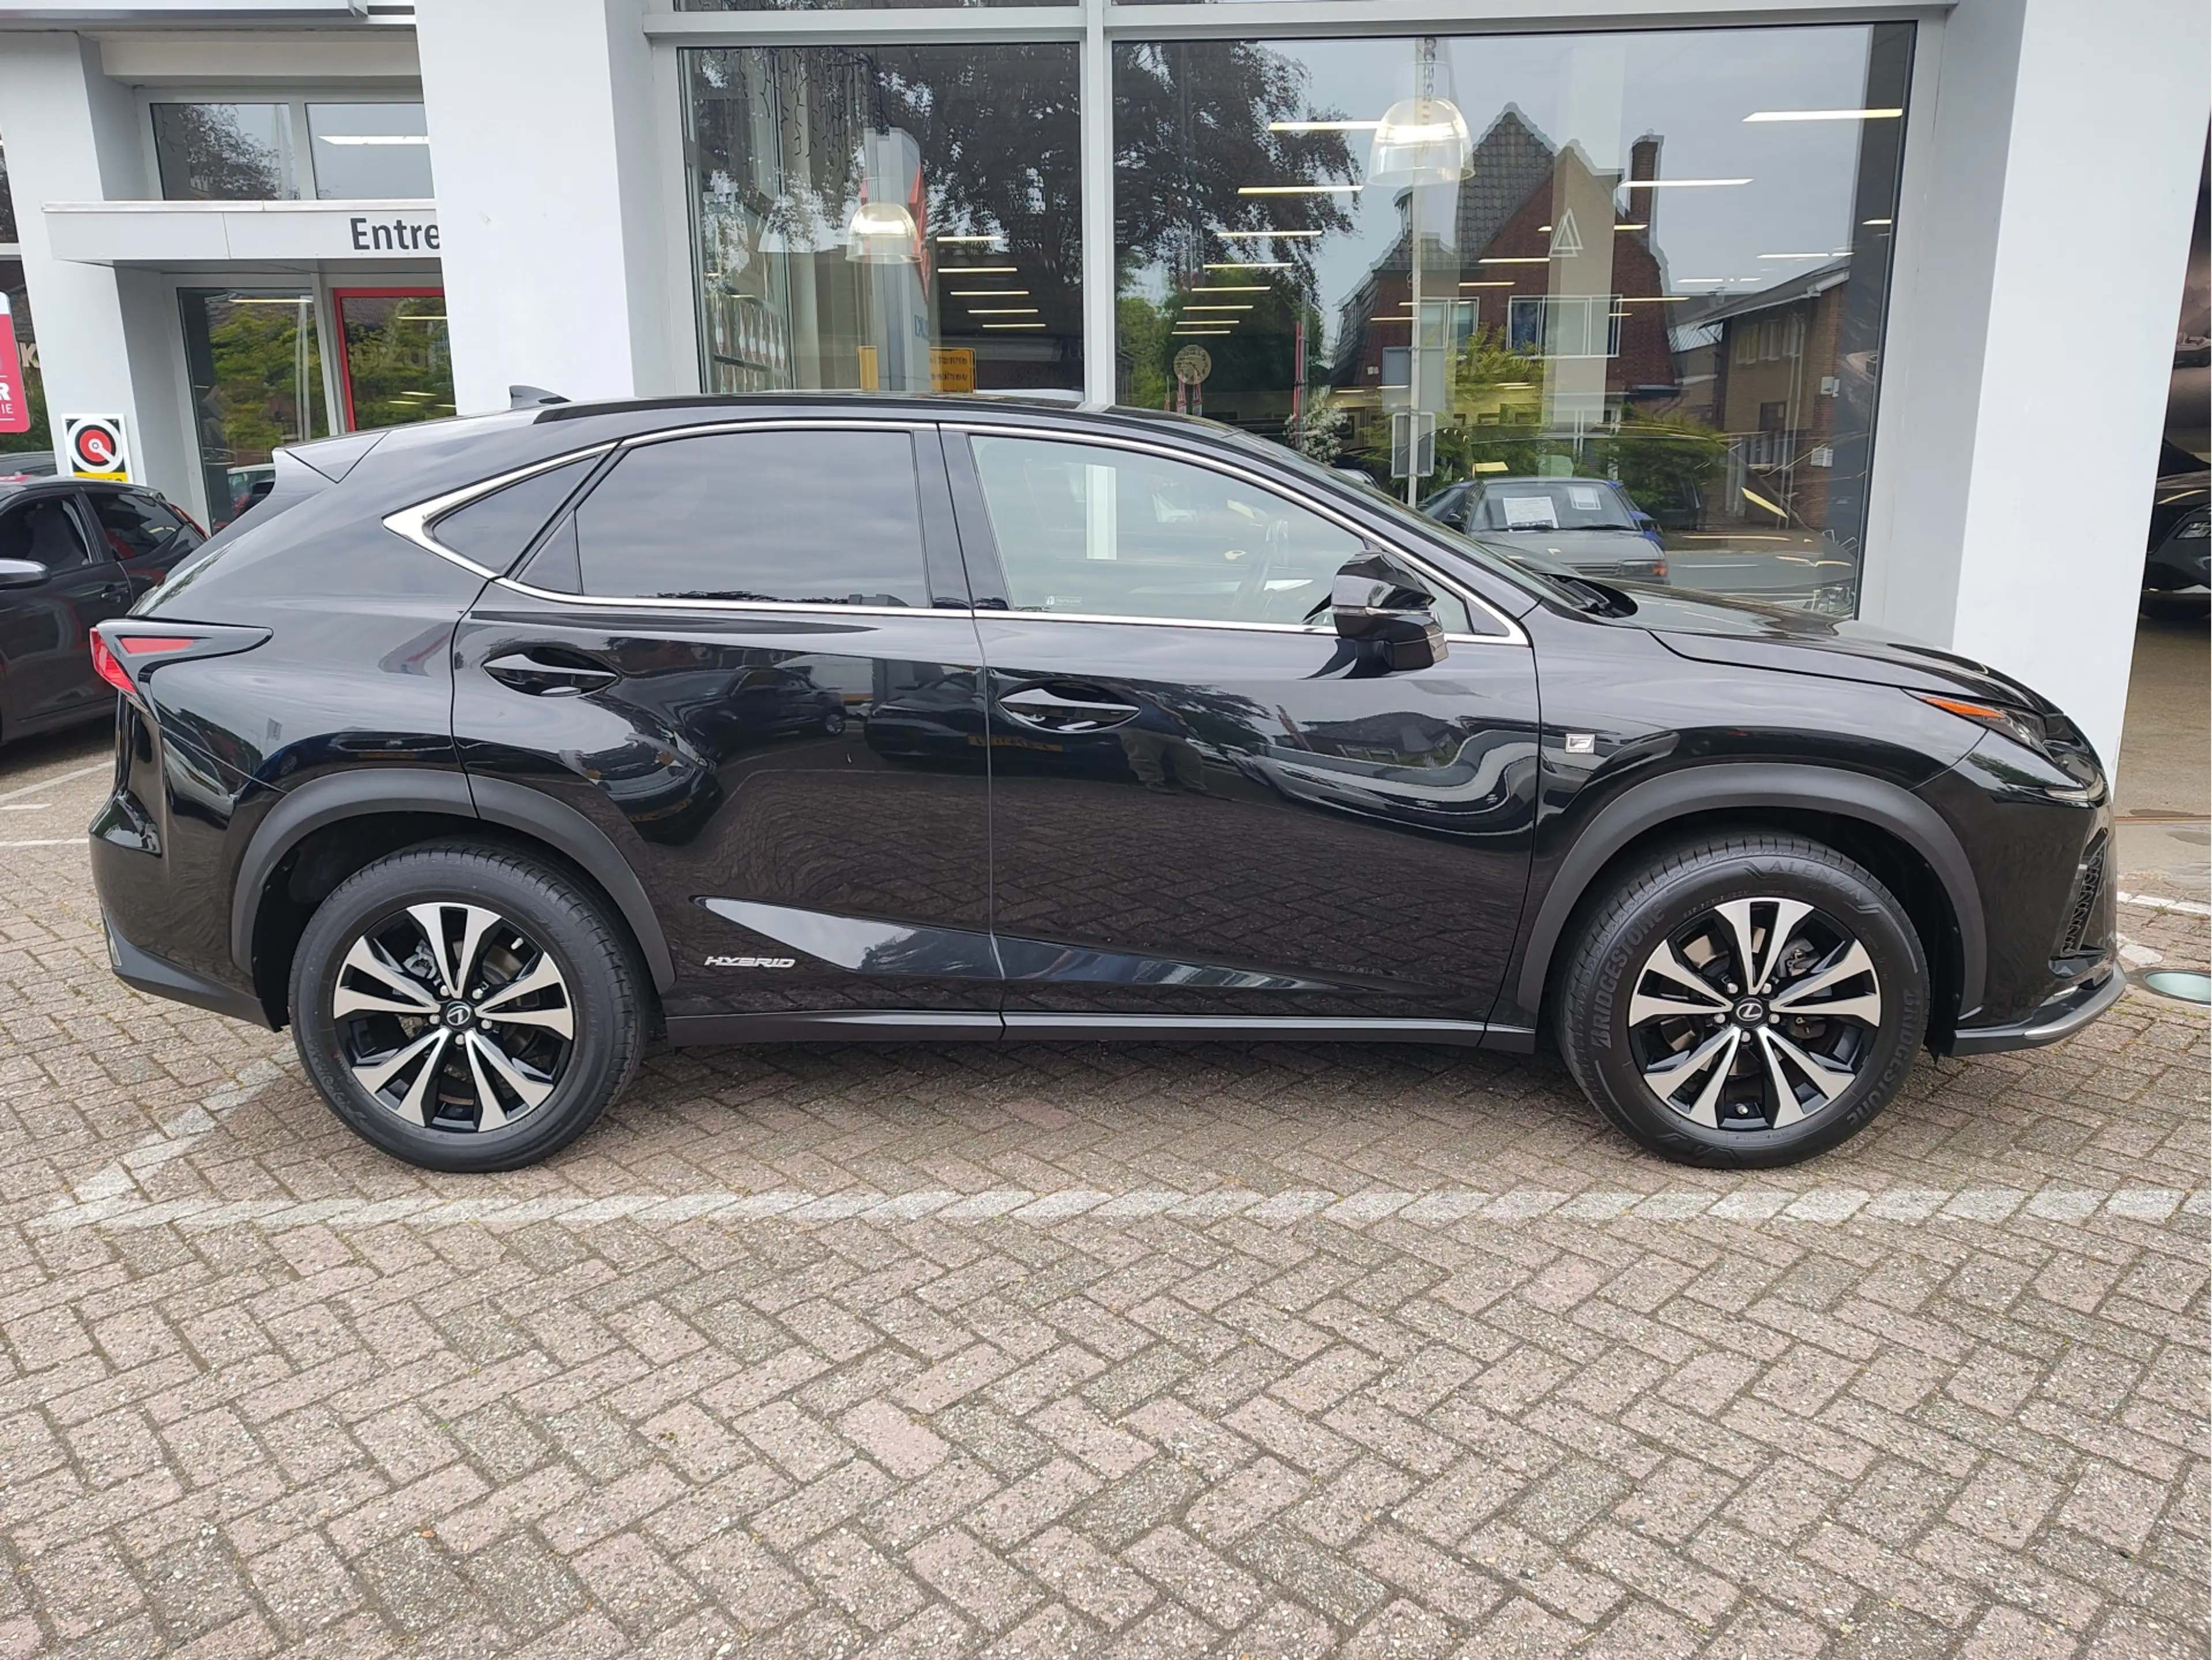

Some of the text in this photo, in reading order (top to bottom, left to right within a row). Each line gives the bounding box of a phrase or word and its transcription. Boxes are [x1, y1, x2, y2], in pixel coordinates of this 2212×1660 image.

[350, 217, 440, 250] Entre
[1769, 860, 1861, 900] ALENZA
[704, 956, 796, 969] HYBRID
[1591, 903, 1665, 1050] BRIDGESTONE
[1847, 989, 1921, 1125] BRIDGESTONE
